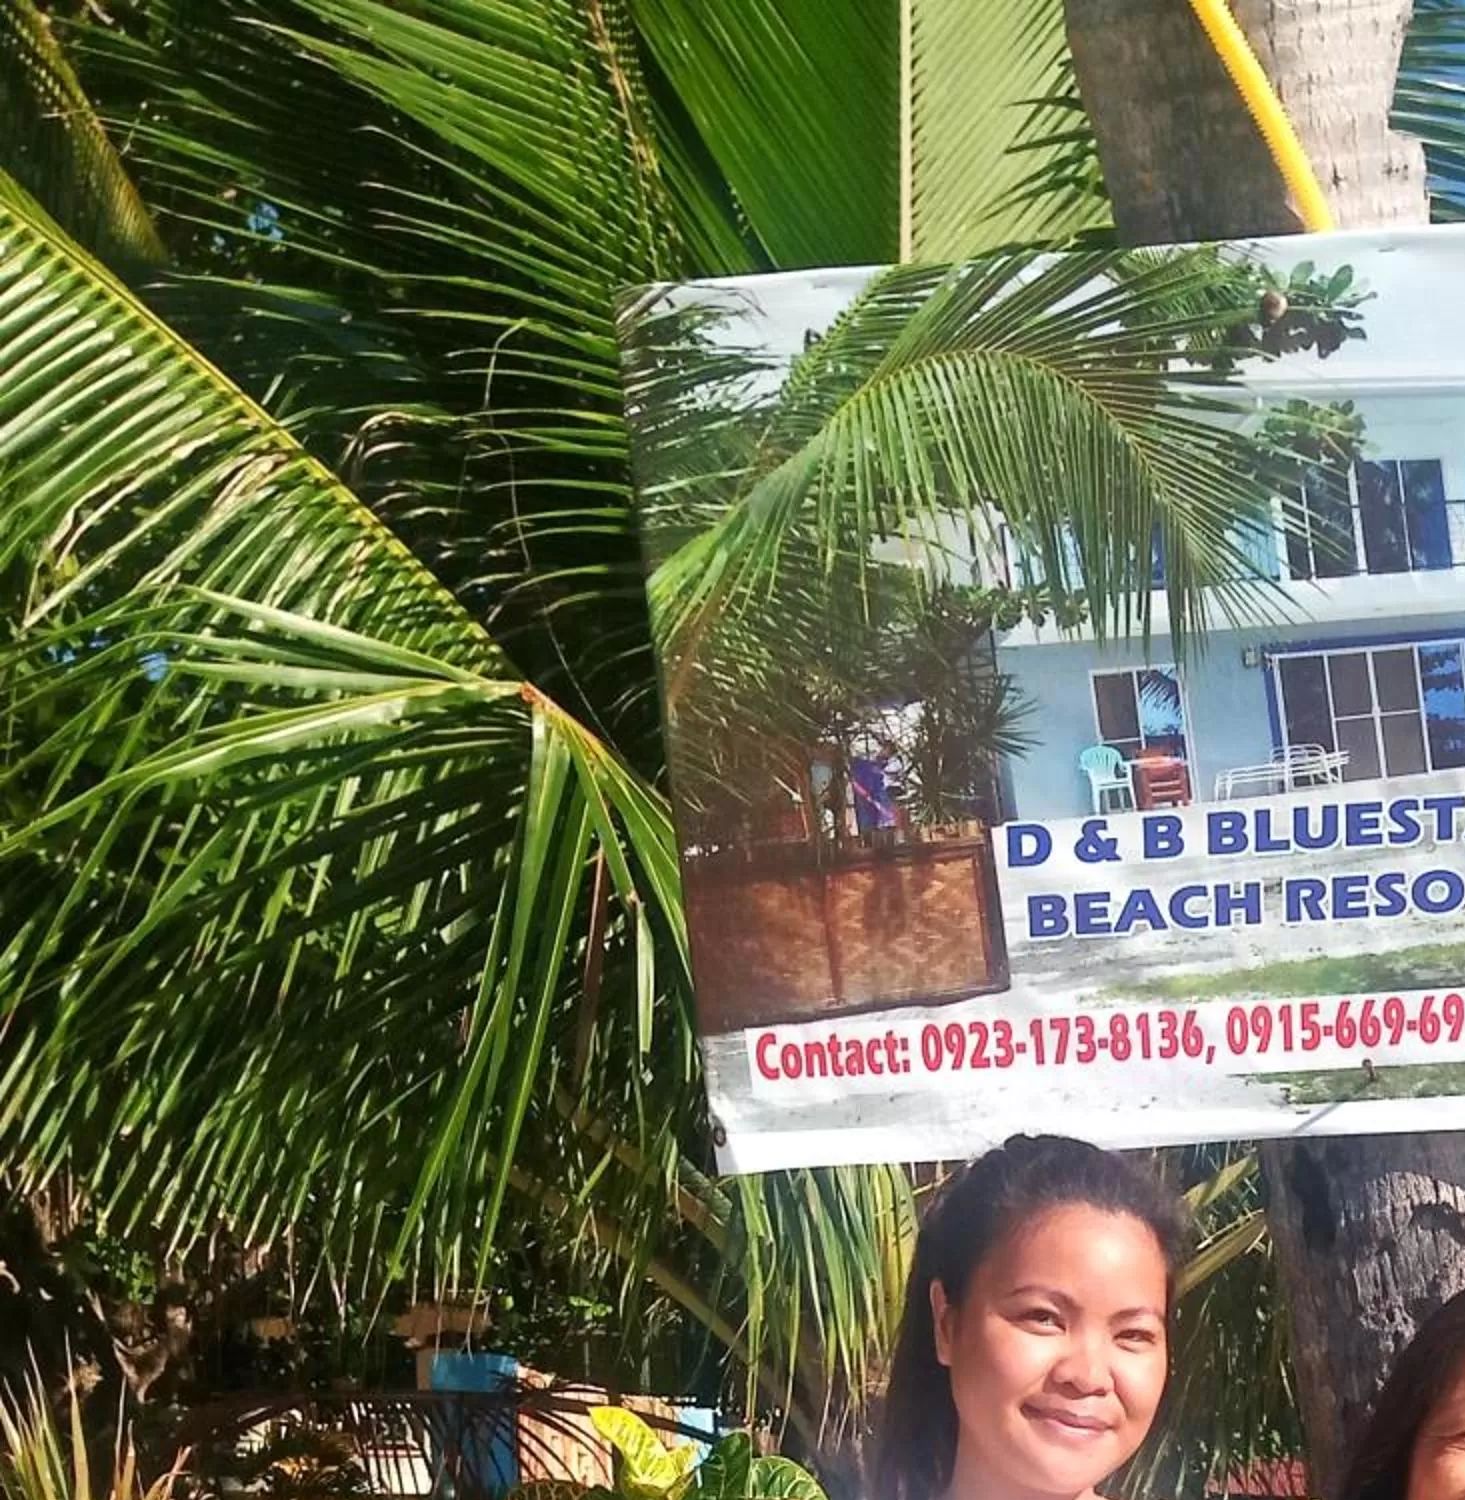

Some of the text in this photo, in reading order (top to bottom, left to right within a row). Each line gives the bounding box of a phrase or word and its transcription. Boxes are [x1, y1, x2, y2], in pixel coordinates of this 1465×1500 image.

[1005, 823, 1052, 868] D
[1073, 818, 1122, 863] &
[1141, 814, 1185, 859] B
[1026, 882, 1263, 938] BEACH
[755, 1029, 911, 1081] Contact:
[920, 1009, 1217, 1072] 0923-173-8136,
